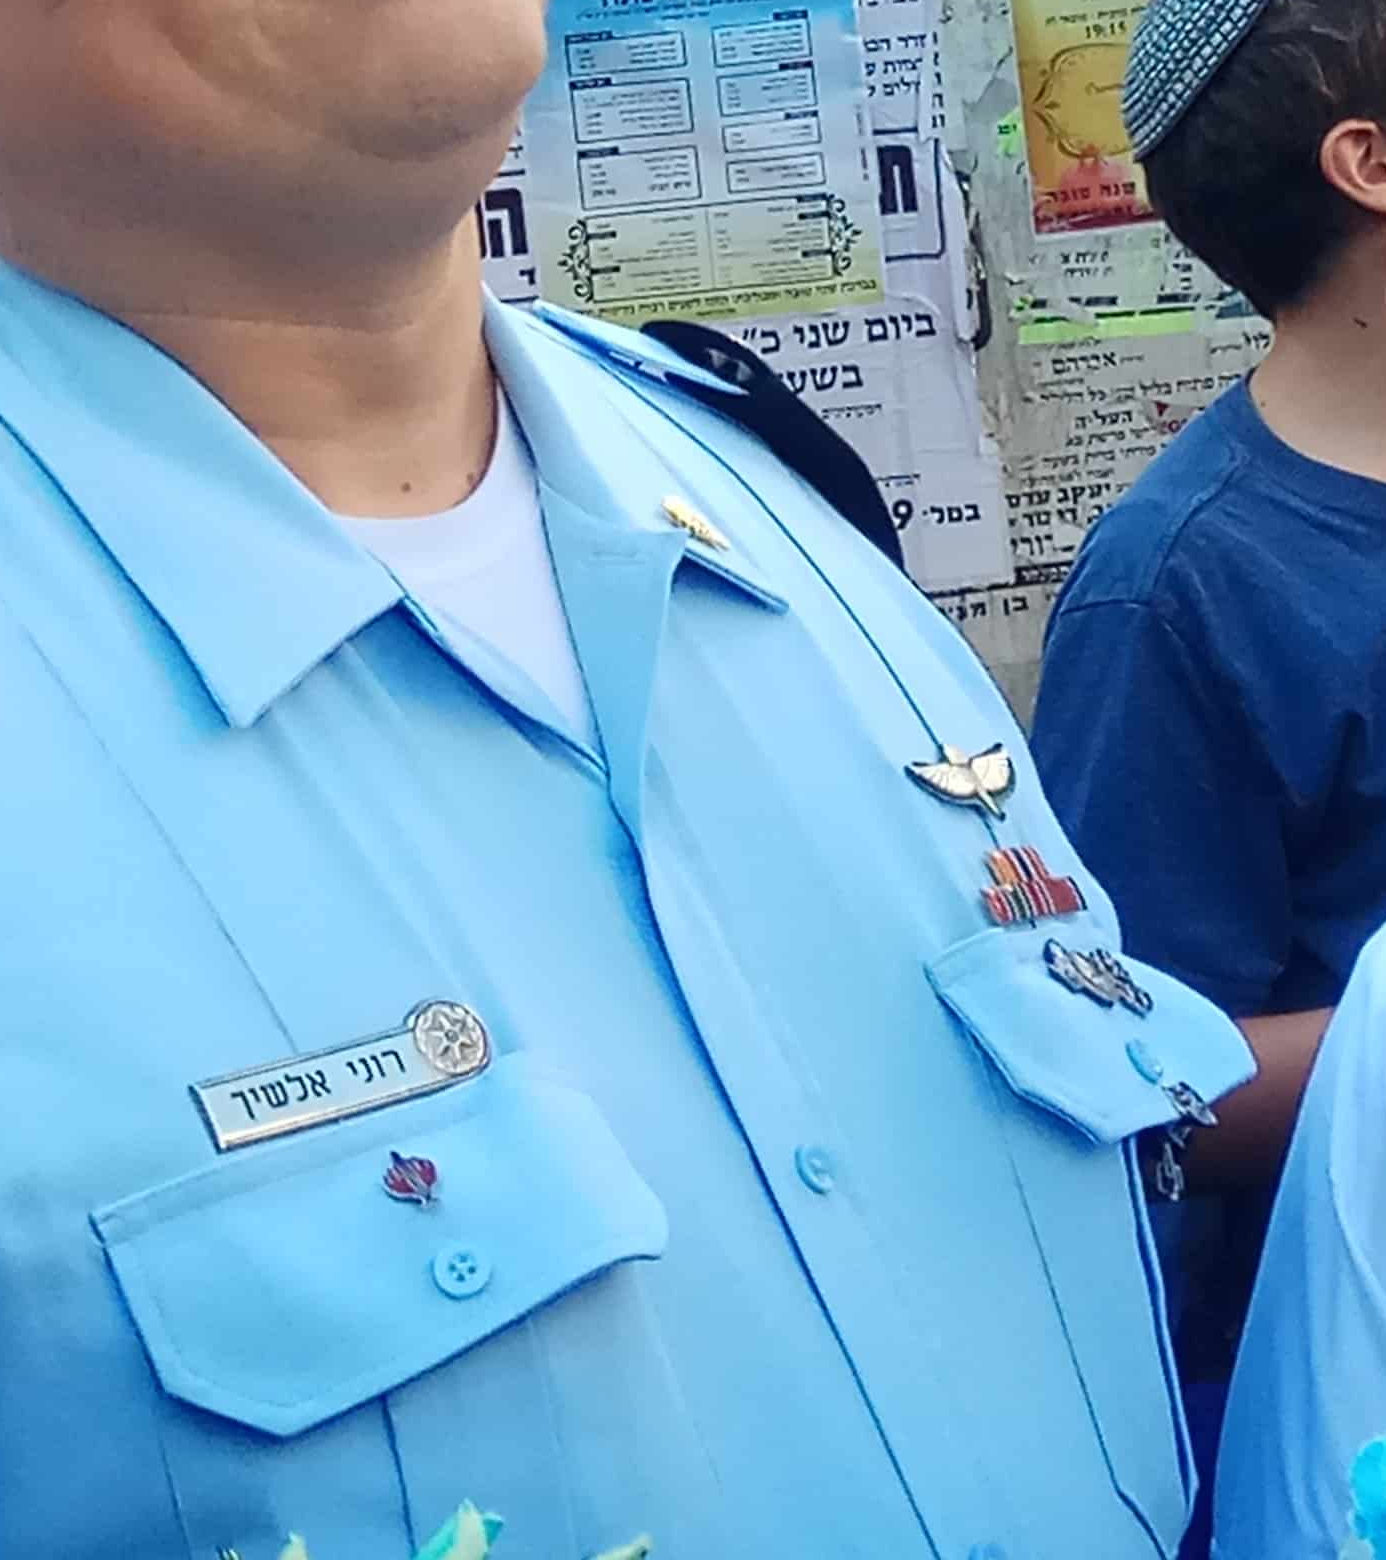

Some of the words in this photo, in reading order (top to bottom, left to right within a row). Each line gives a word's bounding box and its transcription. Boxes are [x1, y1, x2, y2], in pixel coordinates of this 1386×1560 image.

[793, 320, 850, 347] שני
[864, 311, 937, 344] ביום
[1003, 595, 1030, 617] בן
[346, 1046, 407, 1084] רוני
[230, 1067, 332, 1121] אלשיך
